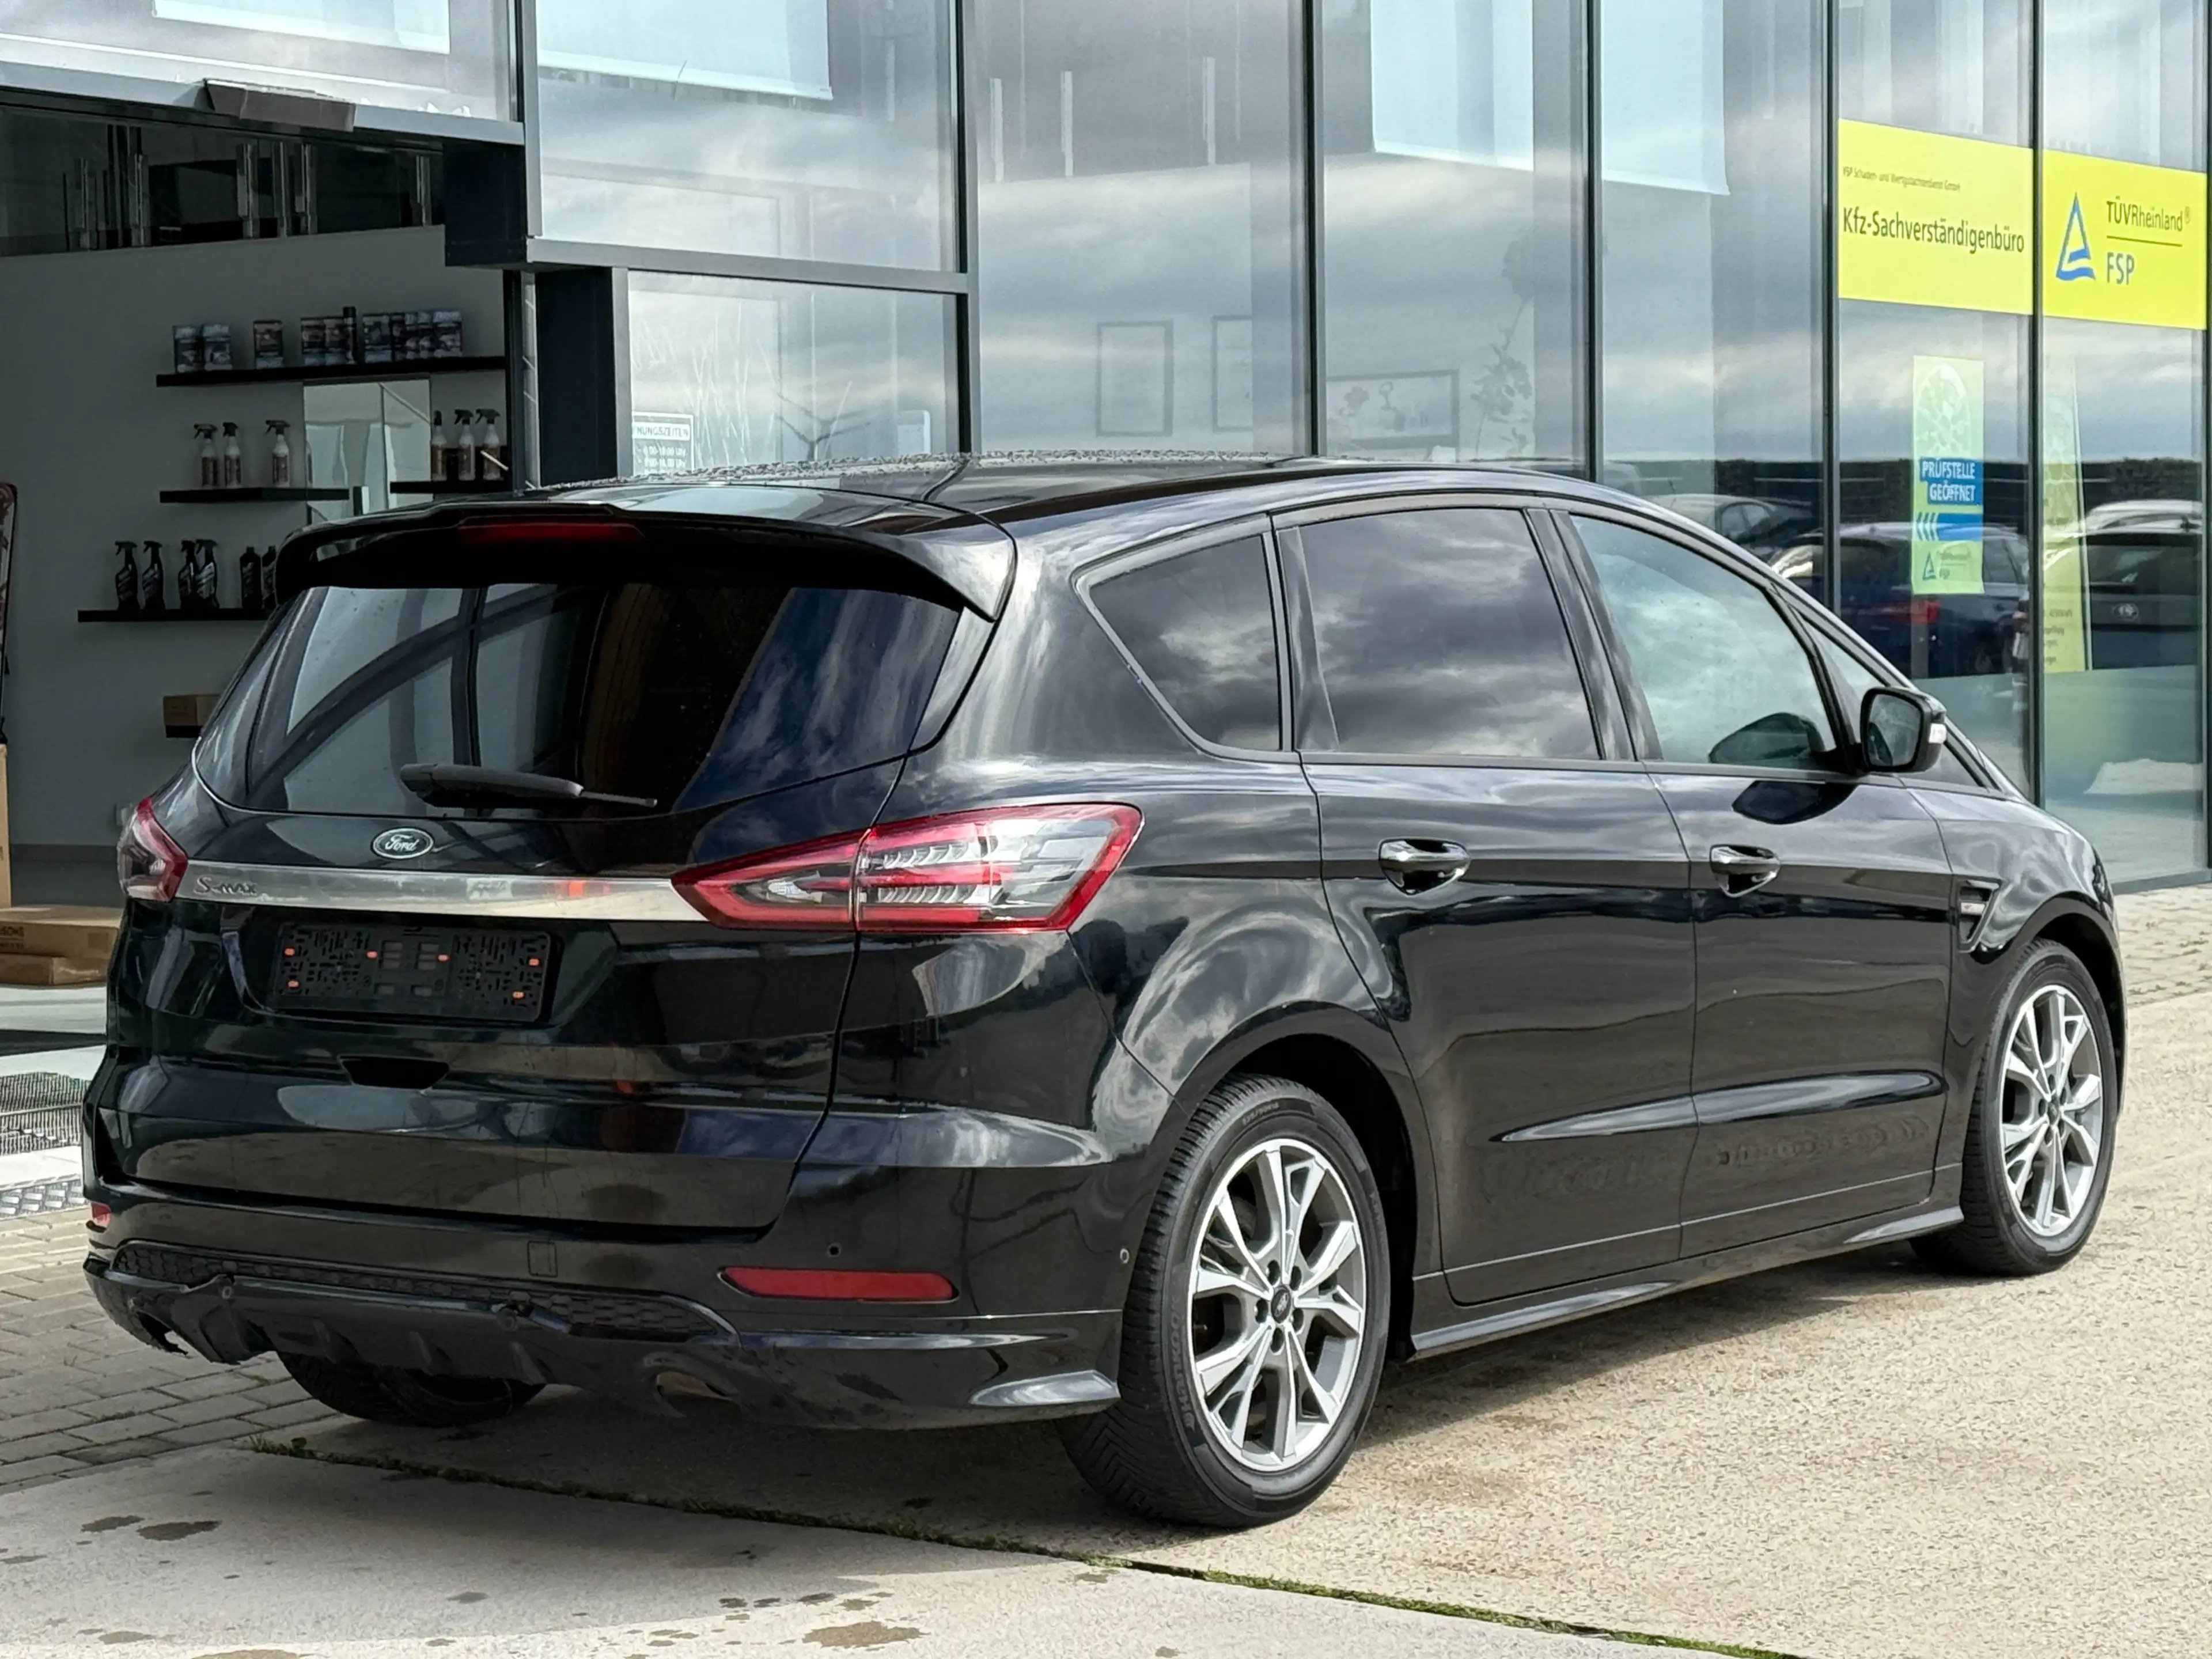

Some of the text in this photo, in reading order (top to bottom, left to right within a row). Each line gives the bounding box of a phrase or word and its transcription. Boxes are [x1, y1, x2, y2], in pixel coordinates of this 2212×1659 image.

[1843, 206, 2024, 254] Kfz-Sachverständigenbüro
[2107, 252, 2135, 285] FSP
[1922, 459, 1975, 479] PRÜFSTELLE
[1930, 479, 1976, 502] GEÖFFNET
[385, 834, 419, 852] Ford
